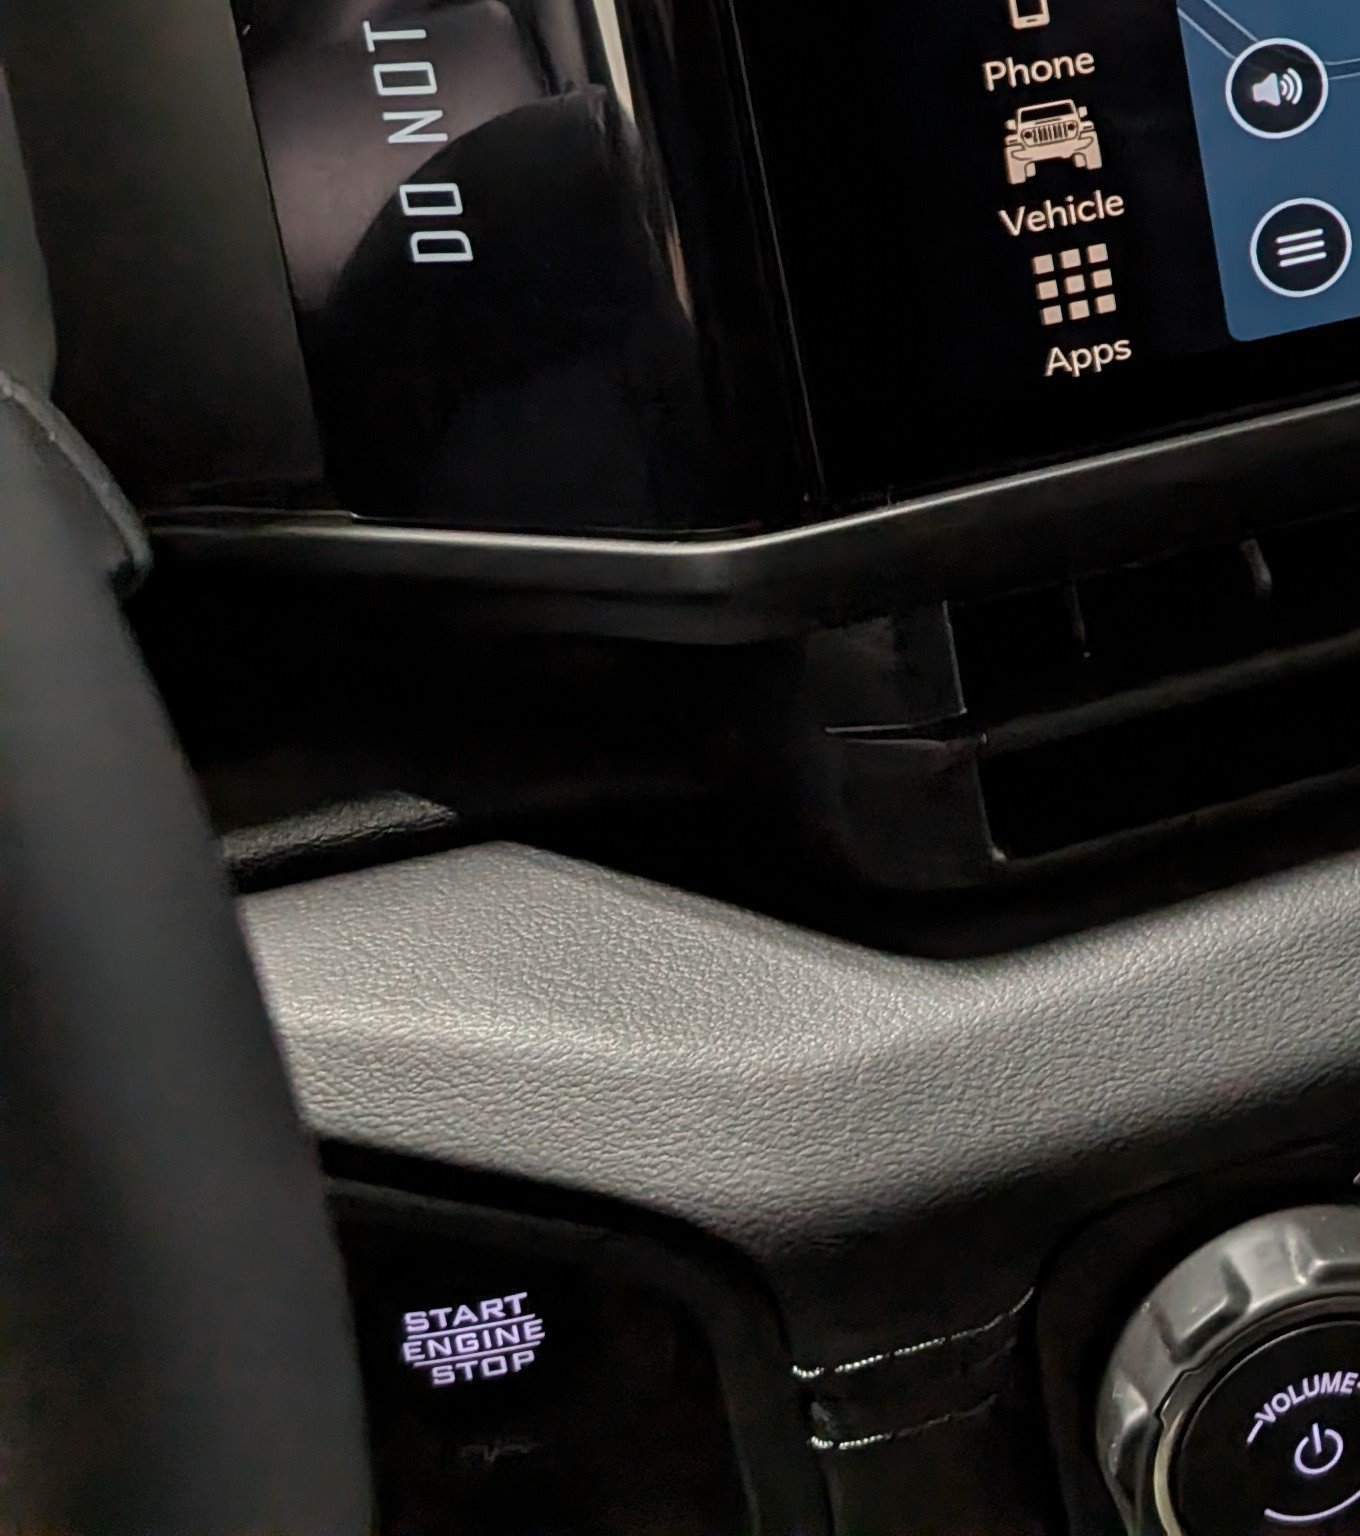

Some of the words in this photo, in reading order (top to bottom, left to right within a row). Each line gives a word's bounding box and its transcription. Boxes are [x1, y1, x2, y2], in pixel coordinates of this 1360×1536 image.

[363, 21, 449, 143] NOT
[984, 50, 1096, 91] Phone
[400, 182, 473, 263] DO
[999, 190, 1125, 236] Vehicle
[1044, 337, 1133, 377] Apps
[403, 1291, 528, 1334] START
[402, 1318, 546, 1363] ENGINE
[432, 1350, 536, 1387] STOP
[1254, 1371, 1360, 1424] VOLUME
